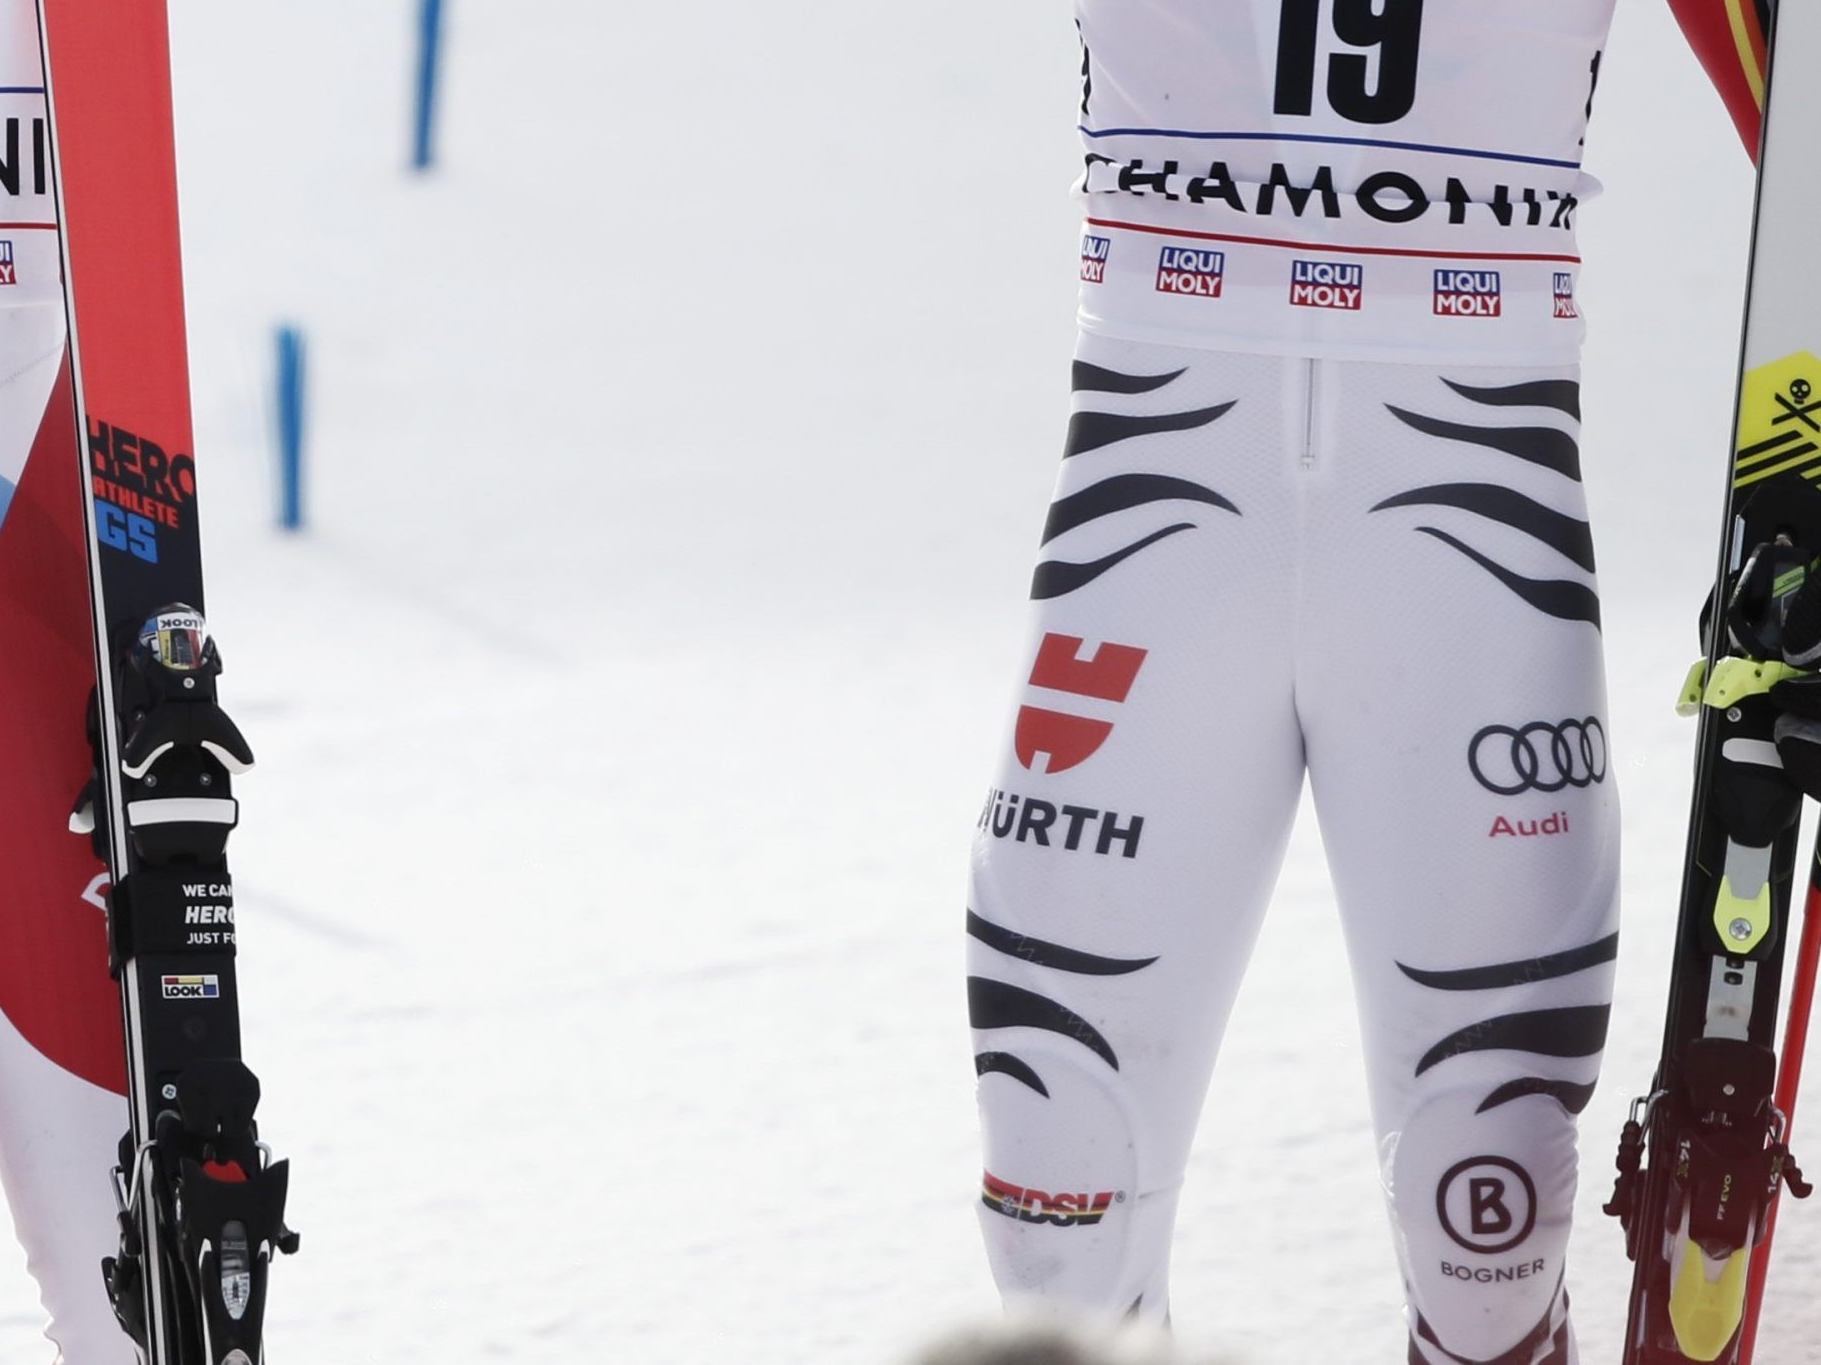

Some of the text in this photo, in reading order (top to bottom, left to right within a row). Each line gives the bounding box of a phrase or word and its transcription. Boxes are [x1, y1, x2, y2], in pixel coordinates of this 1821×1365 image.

[1082, 152, 1578, 230] CHAMONIX
[1161, 248, 1222, 274] LIQUI
[1158, 271, 1222, 295] MOLY
[1294, 262, 1360, 285] LIQUI
[1437, 271, 1498, 293] LIQUI
[1293, 285, 1361, 308] MOLY
[1436, 294, 1499, 316] MOLY
[1554, 297, 1577, 317] MOL
[85, 414, 196, 503] HERO
[93, 477, 180, 529] ATHLETE
[94, 498, 159, 564] GS
[160, 618, 198, 628] LOOK
[1488, 811, 1569, 838] Audi
[182, 884, 206, 897] WE
[186, 932, 220, 945] JUST
[165, 985, 202, 997] LOOK
[1024, 1188, 1114, 1227] DSV
[1440, 1258, 1545, 1283] BOGNER
